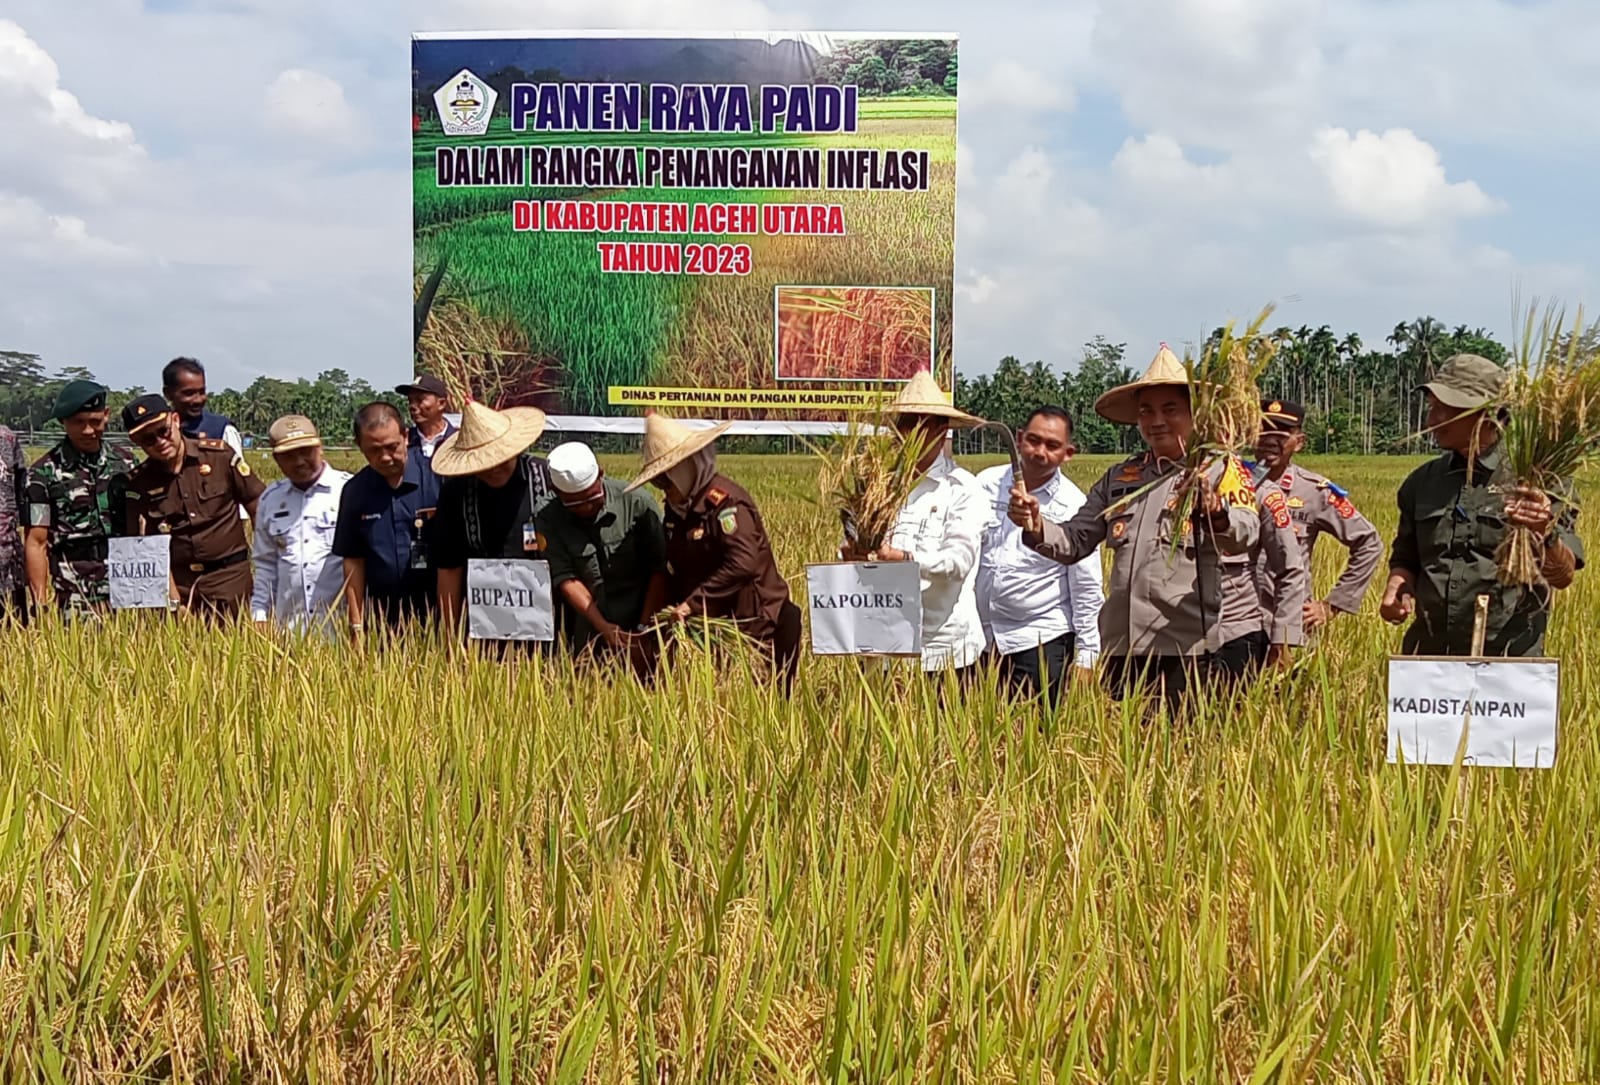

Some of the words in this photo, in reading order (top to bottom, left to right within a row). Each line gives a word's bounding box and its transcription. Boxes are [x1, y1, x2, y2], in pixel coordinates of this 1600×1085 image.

[512, 83, 641, 132] PANEN
[650, 84, 753, 133] RAYA
[760, 84, 858, 134] PADI
[436, 146, 525, 187] DALAM
[529, 146, 641, 188] RANGKA
[643, 147, 821, 190] PENANGANAN
[826, 149, 929, 191] INFLASI
[513, 200, 541, 231] DI
[545, 200, 689, 233] KABUPATEN
[692, 203, 758, 234] ACEH
[762, 204, 845, 236] UTARA
[597, 243, 682, 274] TAHUN
[685, 243, 752, 275] 2023
[621, 390, 656, 401] DINAS
[659, 391, 721, 402] PERTANIAN
[724, 394, 747, 403] DAN
[750, 393, 796, 404] PANGAN
[799, 394, 864, 405] KABUPATEN
[111, 562, 156, 578] KAJARI
[471, 587, 534, 607] BUPATI
[812, 593, 904, 609] KAPOLRES
[1392, 697, 1526, 718] KADISTANPAN
